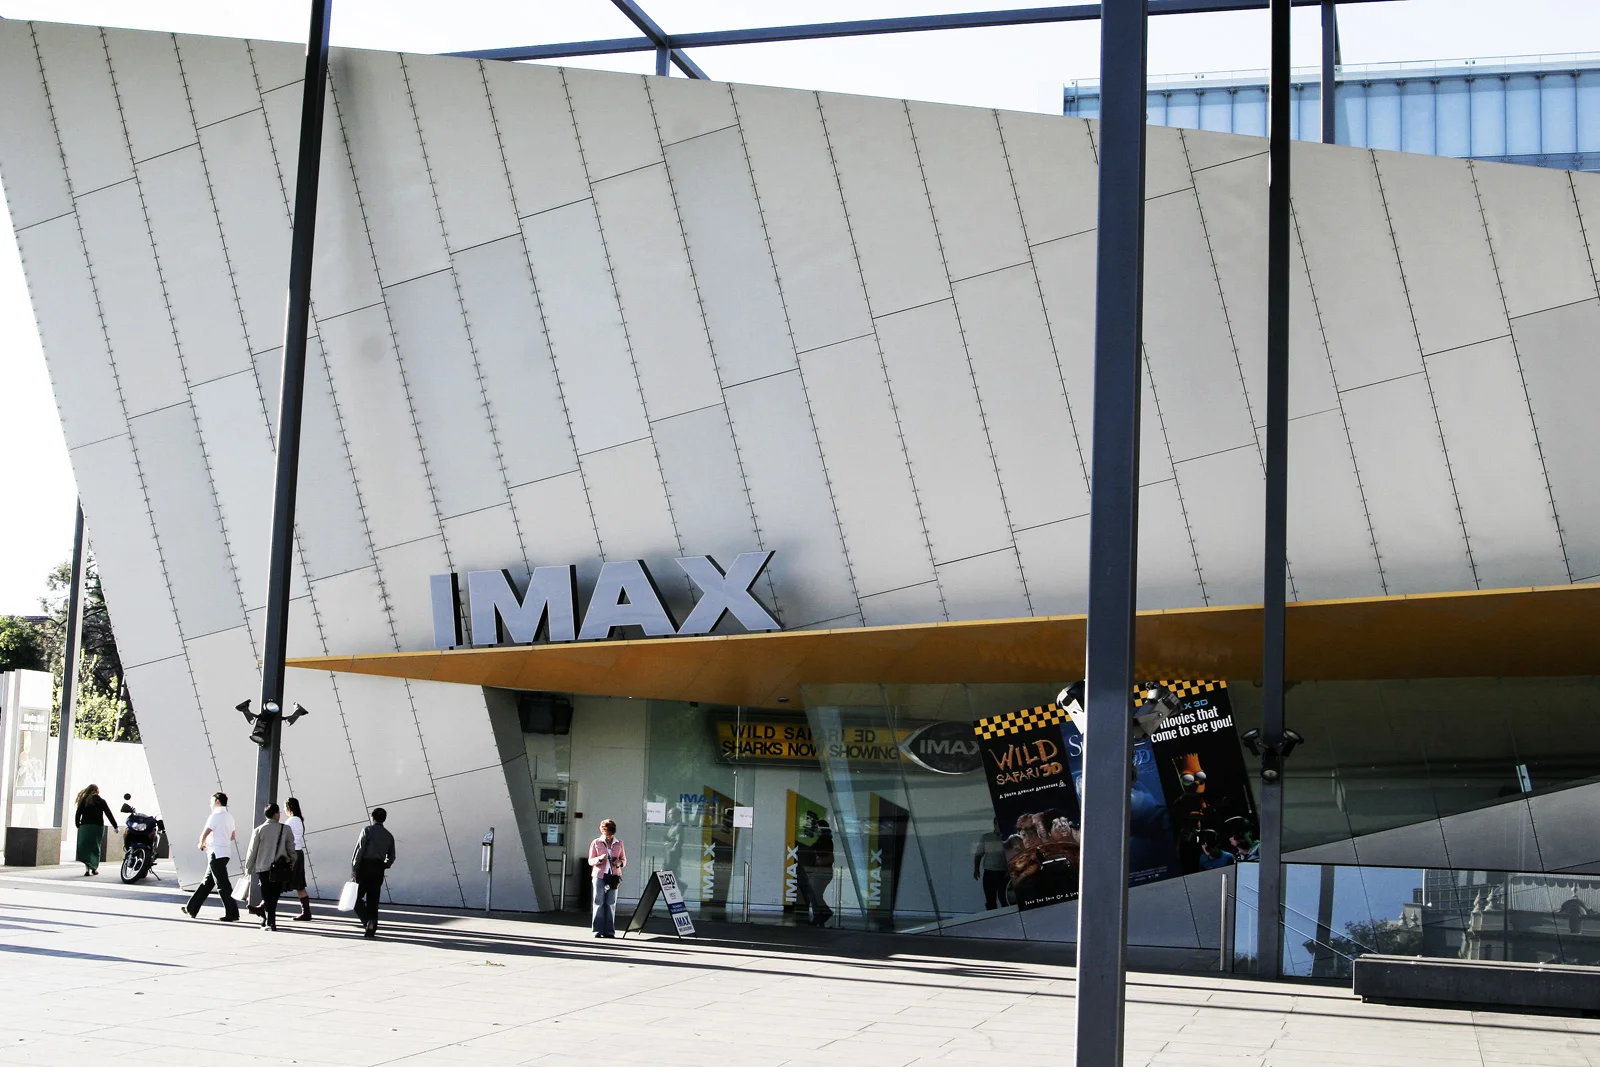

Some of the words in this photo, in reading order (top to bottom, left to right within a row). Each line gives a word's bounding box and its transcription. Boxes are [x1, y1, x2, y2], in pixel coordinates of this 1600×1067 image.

[430, 551, 782, 647] IMAX
[1193, 699, 1209, 707] 3D
[1151, 730, 1178, 743] come
[1179, 726, 1190, 737] to
[1192, 722, 1209, 734] see
[1210, 715, 1233, 732] you!
[1160, 713, 1196, 729] movies
[1196, 706, 1219, 721] that
[730, 724, 776, 739] WILD
[854, 729, 876, 743] 3D
[722, 740, 782, 756] SHARKS
[829, 745, 899, 760] SHOWING
[988, 740, 1058, 770] WILD
[996, 767, 1040, 785] SAFARI
[1040, 762, 1063, 777] 3D
[680, 793, 720, 804] IMAX
[703, 842, 716, 899] IMAX
[785, 845, 798, 902] IMAX
[870, 849, 882, 906] IMAX
[675, 915, 691, 927] IMAX
